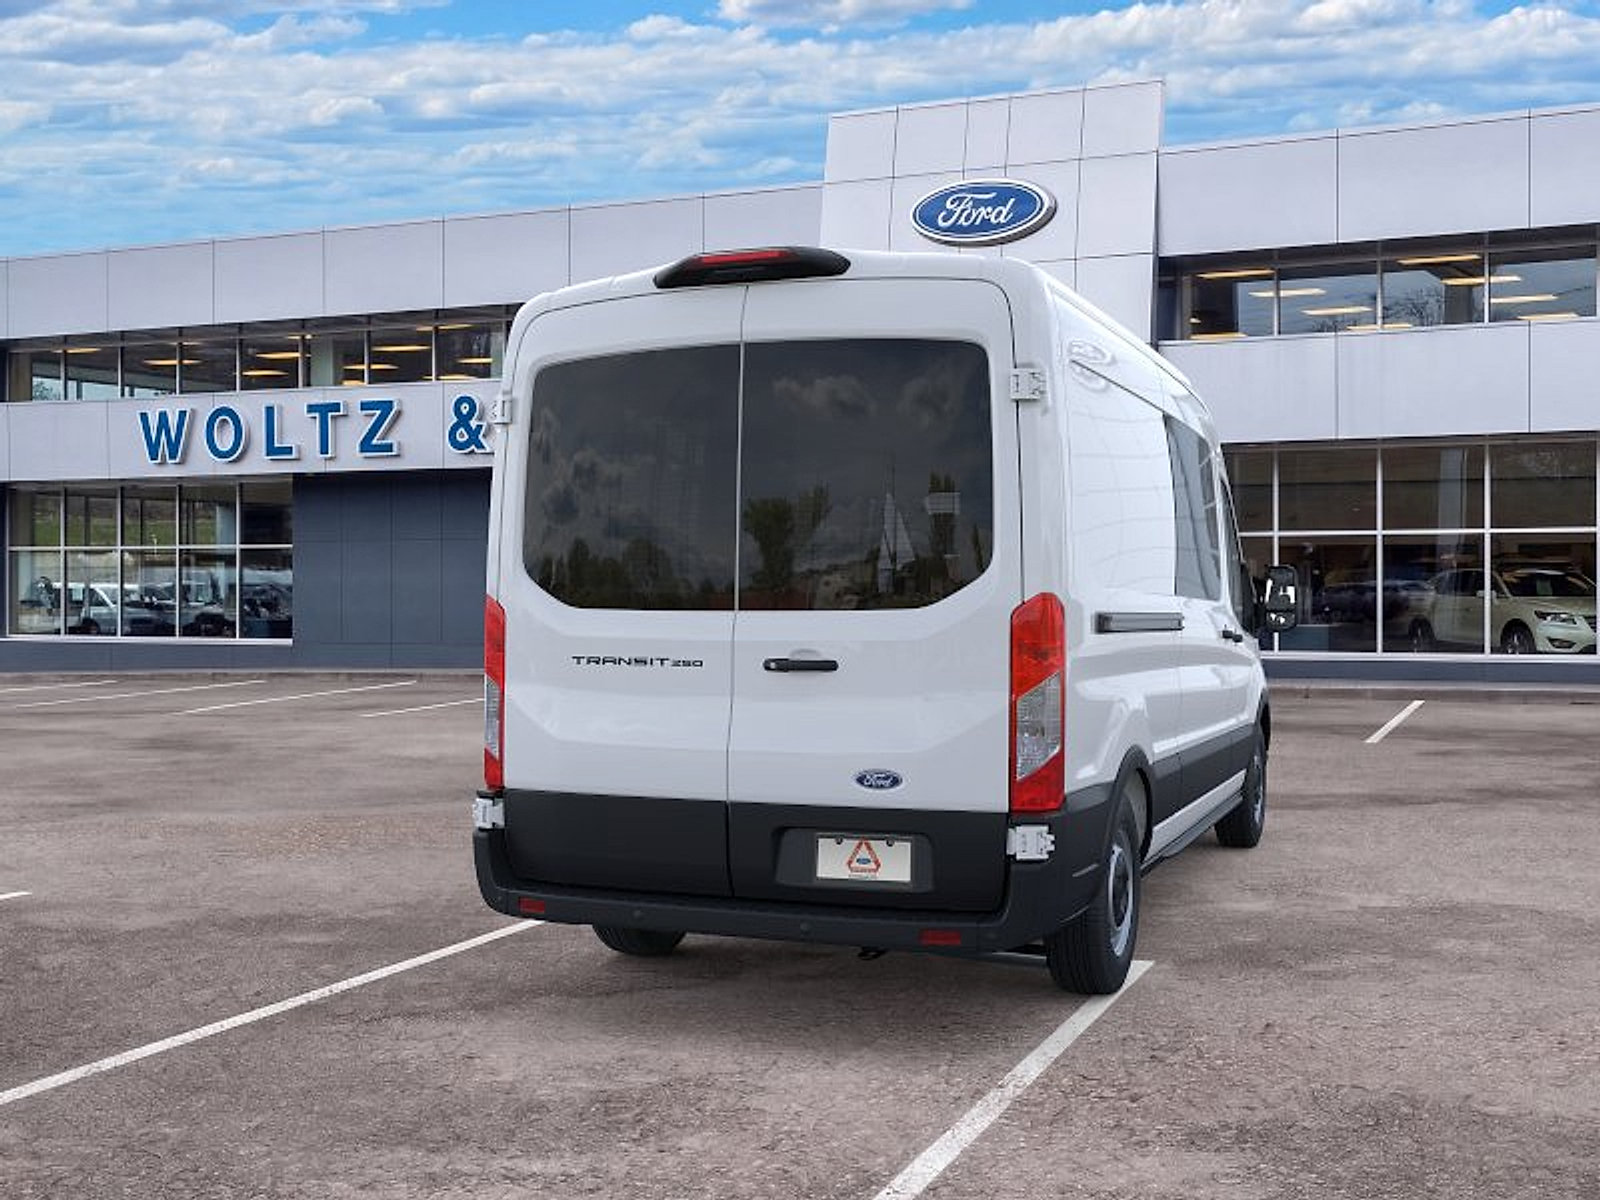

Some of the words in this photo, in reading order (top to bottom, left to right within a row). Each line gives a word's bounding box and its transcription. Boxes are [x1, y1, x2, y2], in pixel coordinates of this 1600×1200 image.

[938, 192, 1015, 228] Ford
[138, 399, 398, 463] WOLTZ
[447, 395, 488, 453] &
[571, 655, 670, 666] TRANSIT
